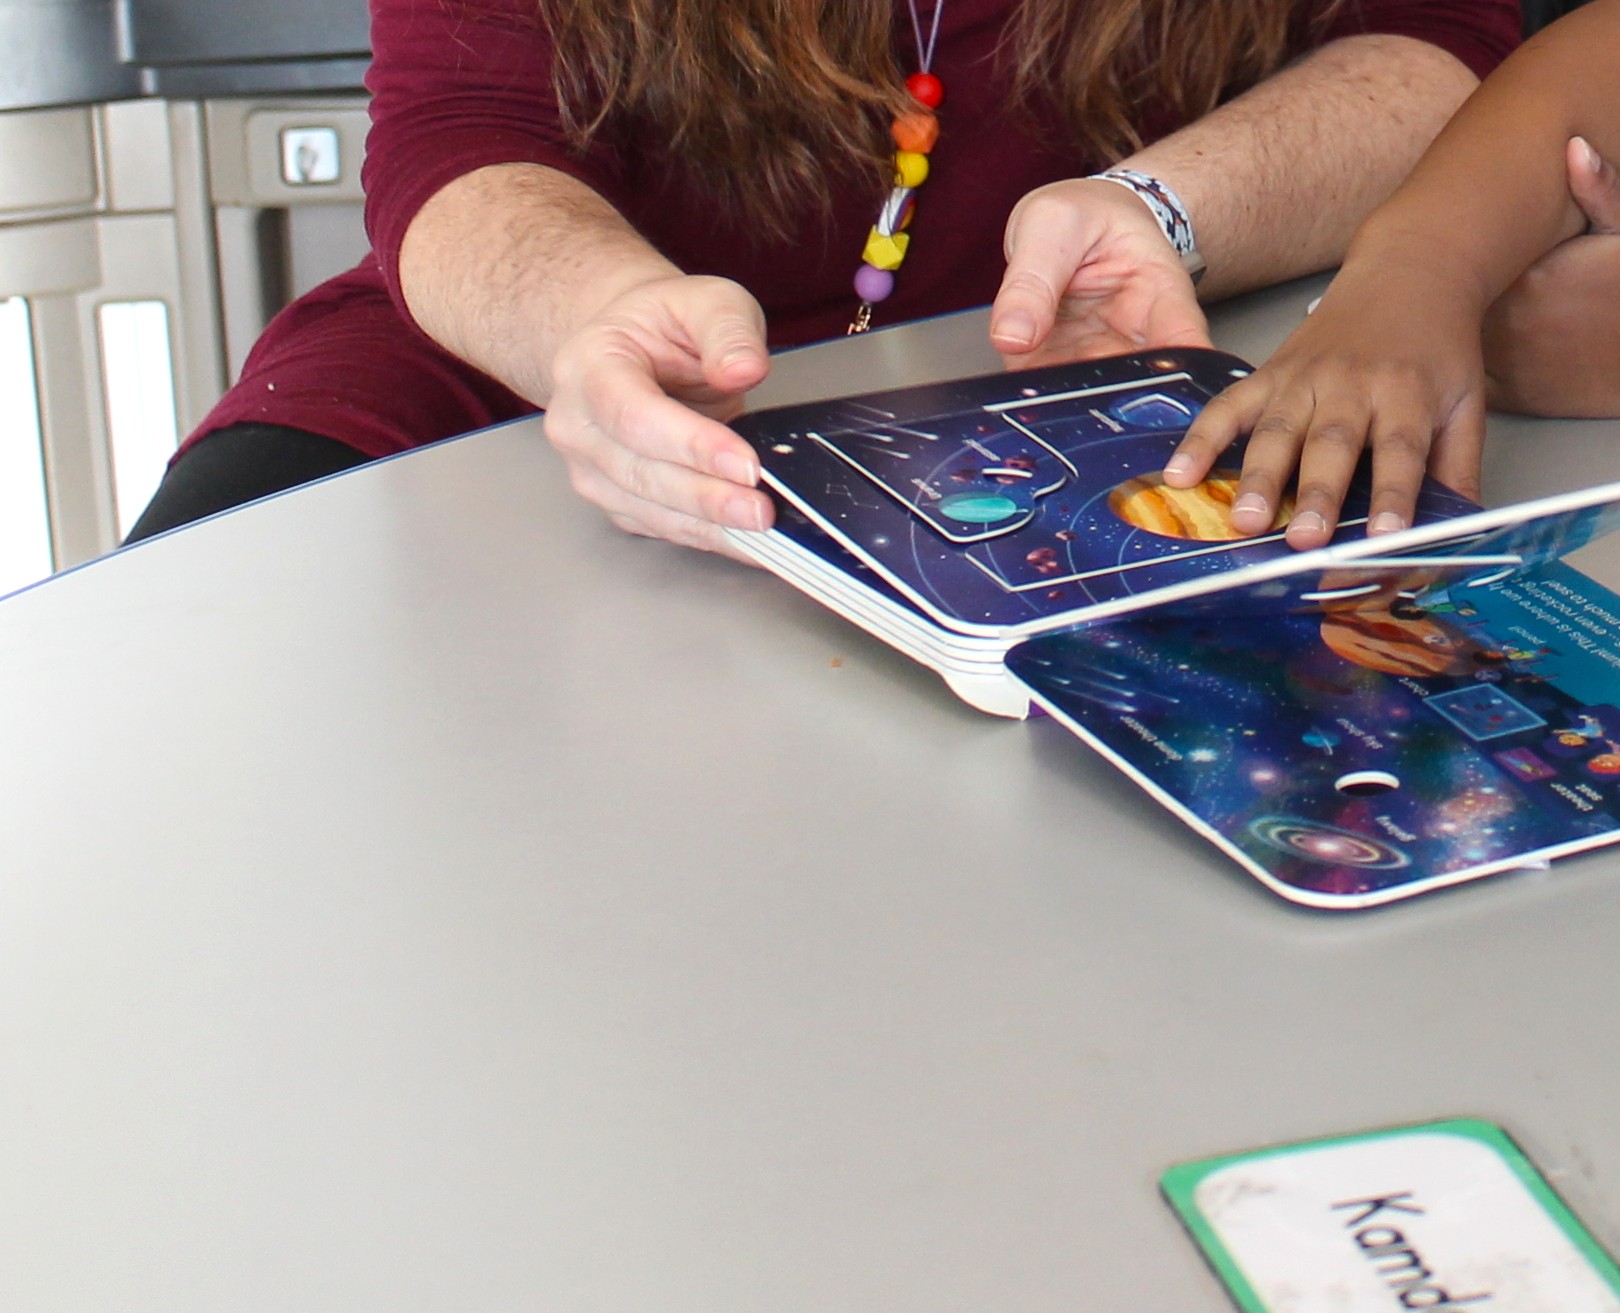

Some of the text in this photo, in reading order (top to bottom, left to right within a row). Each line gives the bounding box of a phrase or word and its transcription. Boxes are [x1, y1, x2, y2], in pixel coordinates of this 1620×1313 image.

[1540, 579, 1574, 595] see!
[1519, 580, 1579, 617] rocketing
[1570, 594, 1587, 605] to
[1519, 600, 1560, 625] where
[1556, 624, 1572, 633] is
[1574, 616, 1607, 635] even
[1568, 631, 1597, 650] This
[1329, 1189, 1494, 1313] Kamd
